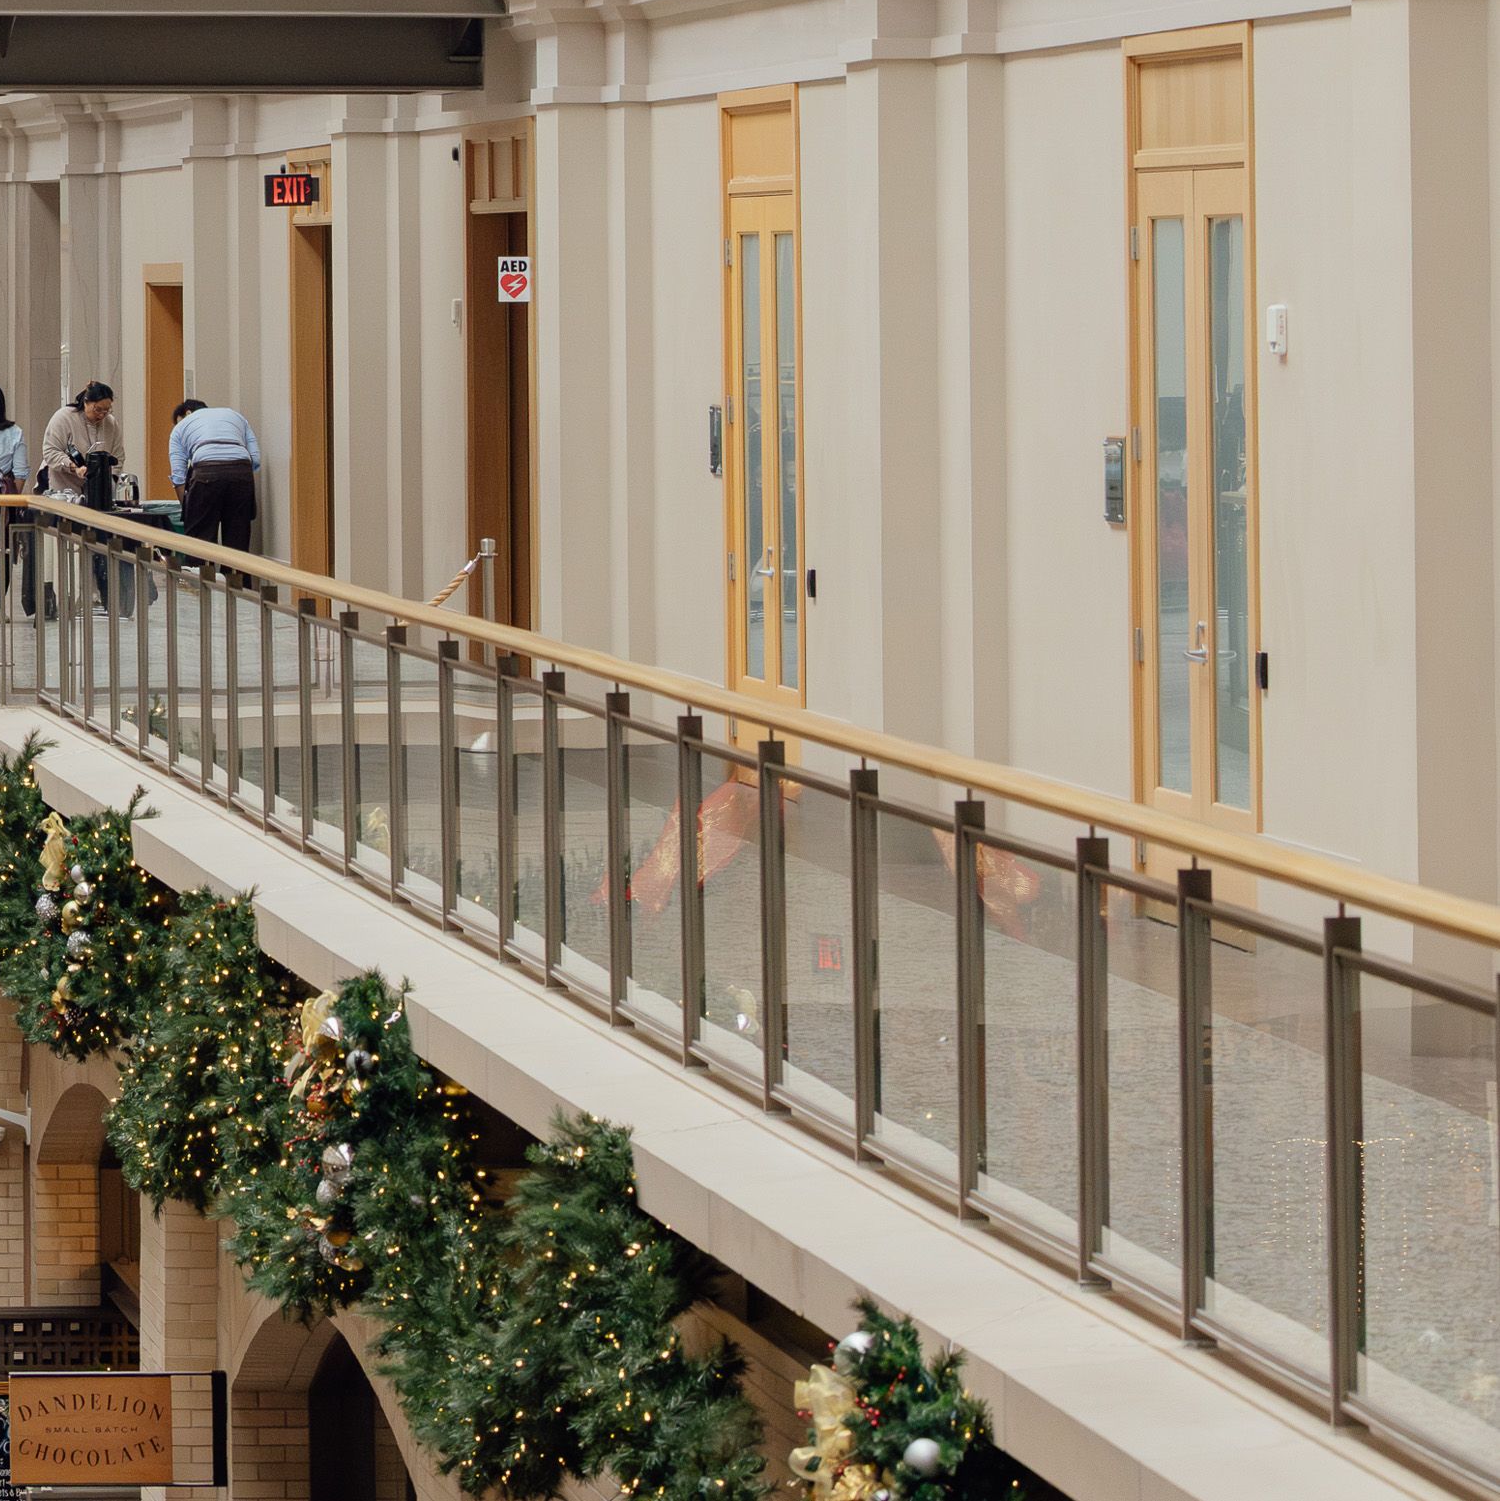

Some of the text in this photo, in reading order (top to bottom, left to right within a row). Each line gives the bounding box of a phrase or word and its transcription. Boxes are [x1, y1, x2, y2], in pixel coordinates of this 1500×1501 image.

[273, 177, 306, 204] EXIT
[500, 260, 528, 273] AED
[18, 1393, 165, 1422] DANDELION
[45, 1426, 138, 1434] SMALL BATCH
[19, 1435, 165, 1467] CHOCOLATE
